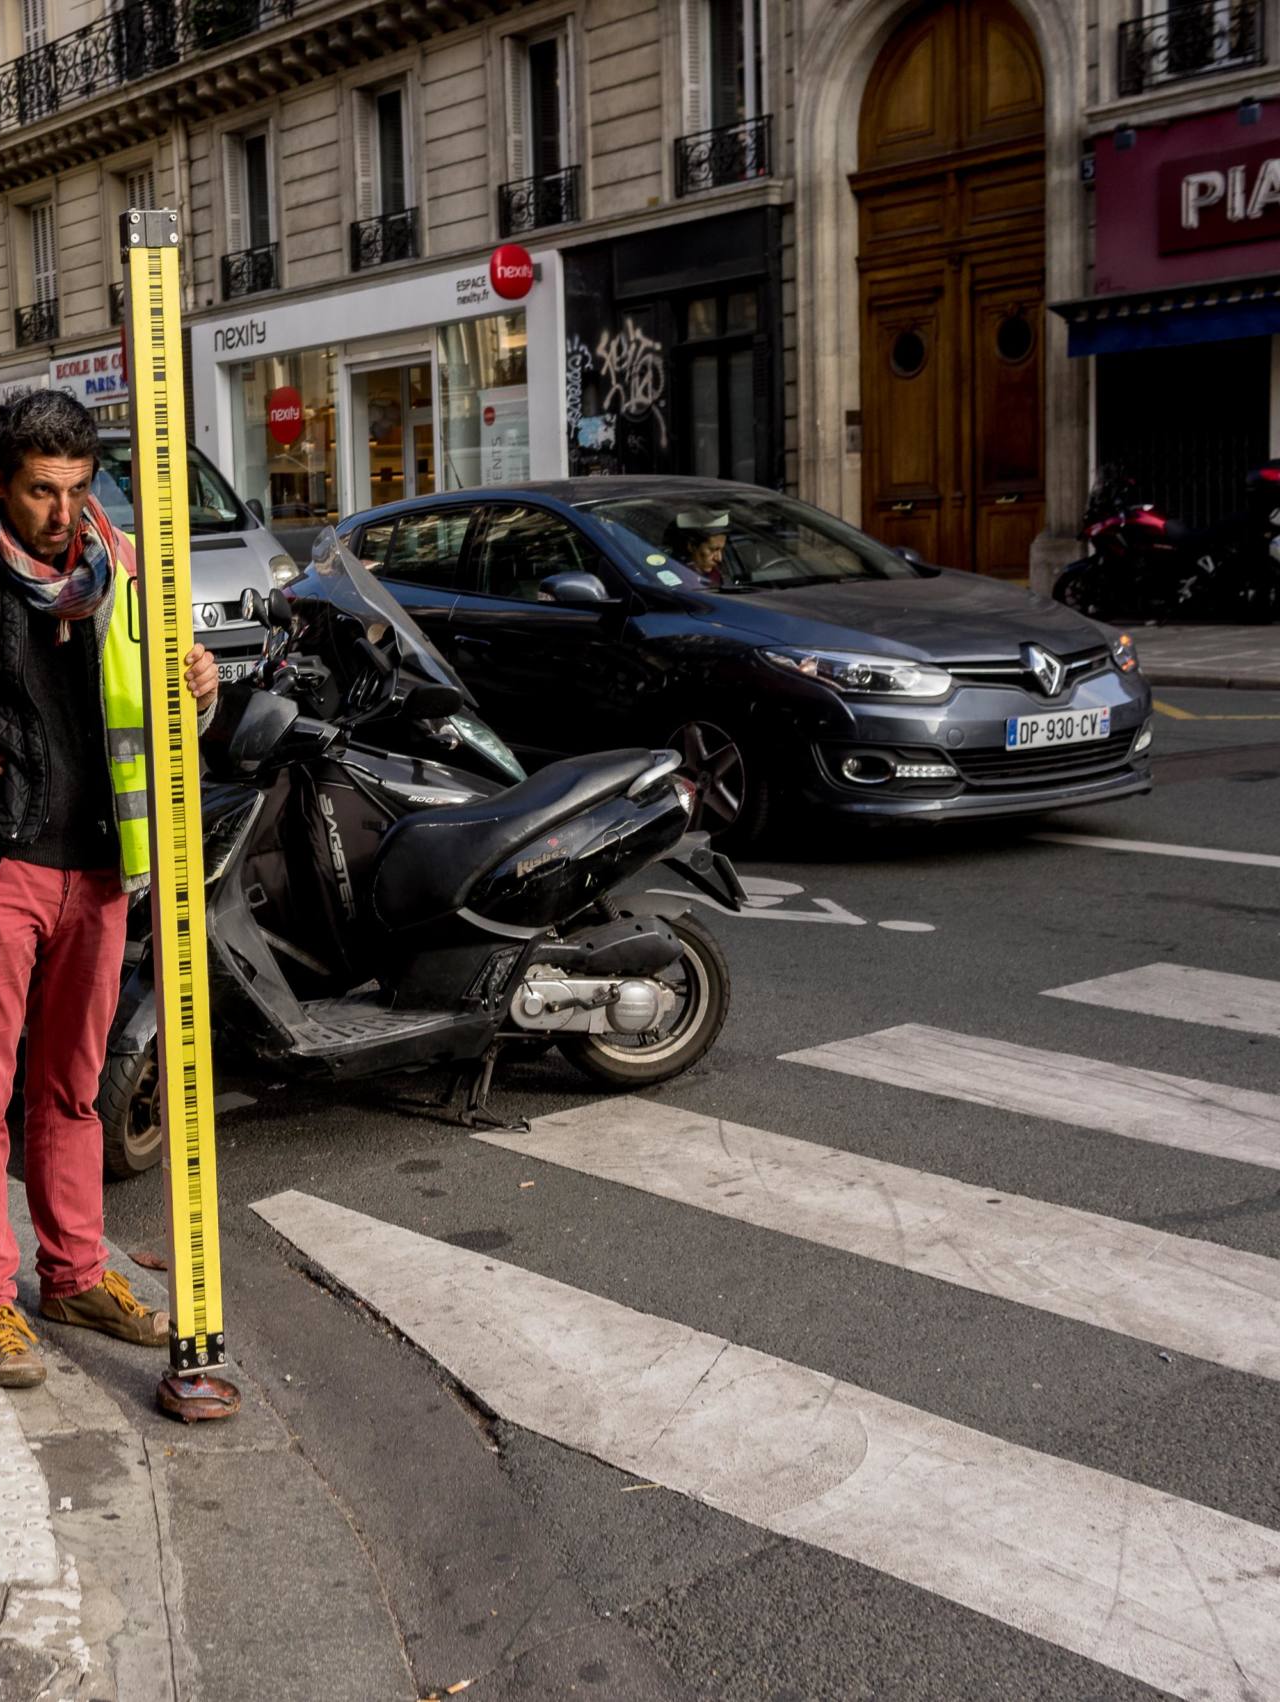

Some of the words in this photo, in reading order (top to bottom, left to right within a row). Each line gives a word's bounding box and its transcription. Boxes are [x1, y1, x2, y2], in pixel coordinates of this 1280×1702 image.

[496, 264, 533, 280] nexity
[456, 276, 487, 293] ESPACE
[456, 291, 490, 306] nexity.fr
[214, 319, 267, 352] nexity
[56, 359, 90, 380] ECOLE
[93, 356, 109, 373] DE
[85, 376, 116, 395] PARIS
[270, 408, 300, 424] nexity
[1020, 713, 1098, 744] DP-930-CV
[319, 794, 356, 920] BAGSTER
